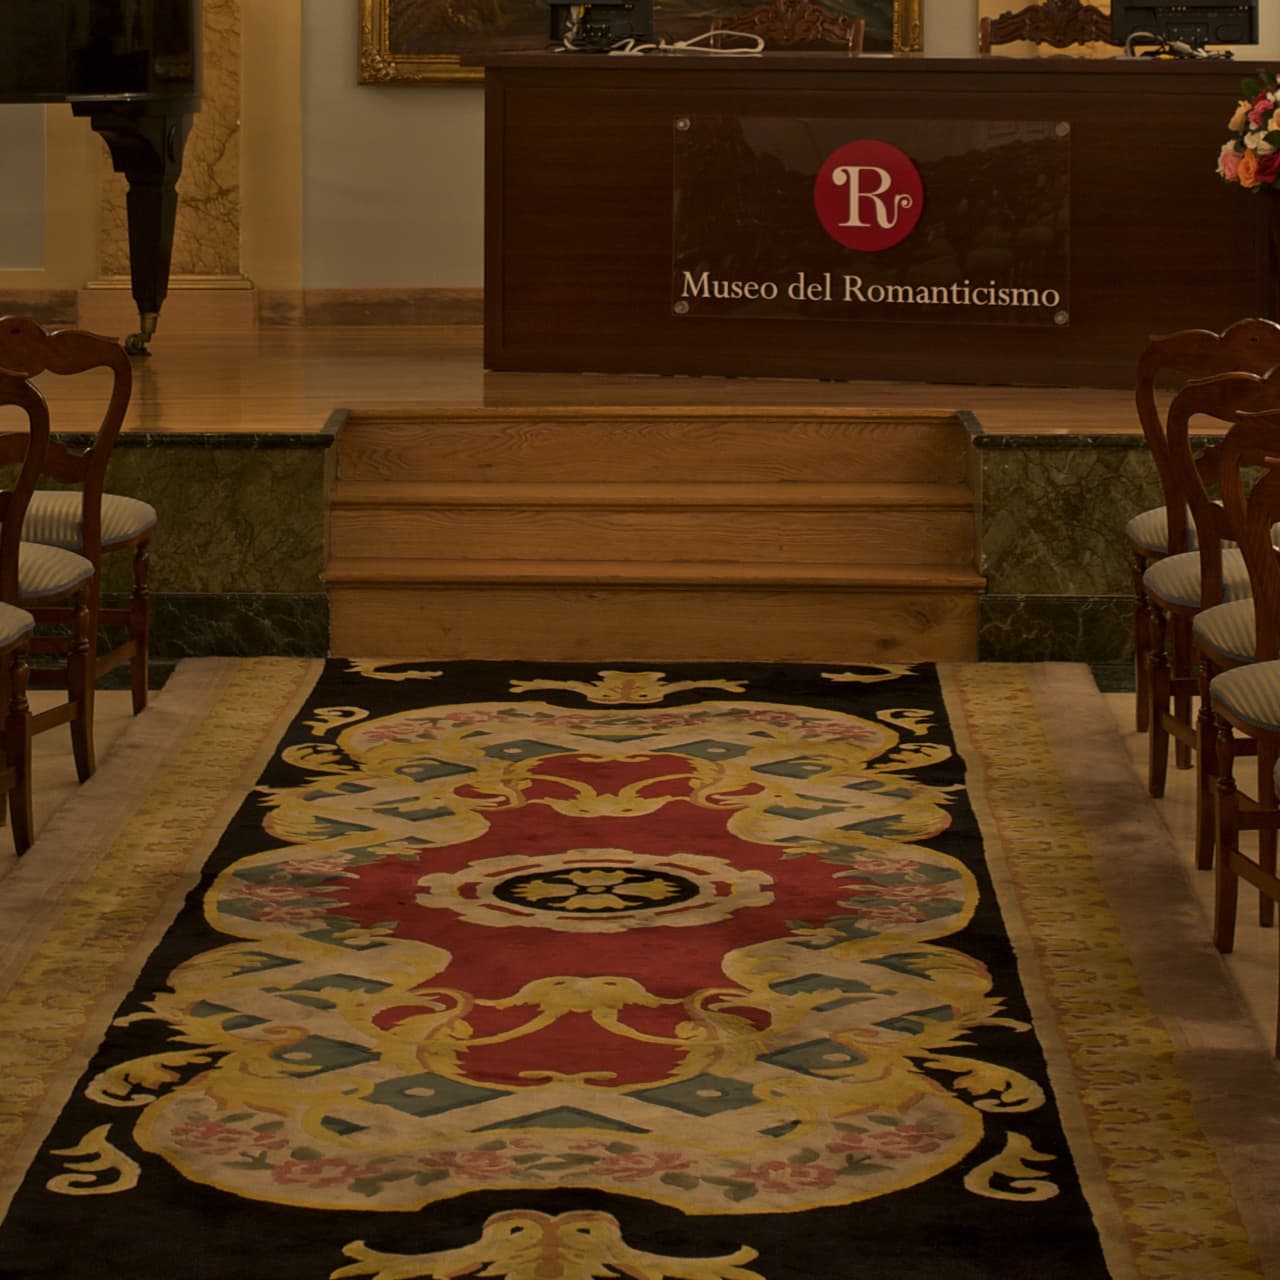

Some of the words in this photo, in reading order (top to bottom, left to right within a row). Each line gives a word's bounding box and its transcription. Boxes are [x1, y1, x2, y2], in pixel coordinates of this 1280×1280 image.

[681, 270, 779, 300] Museo
[787, 271, 833, 302] del
[843, 275, 1061, 308] Romanticismo
